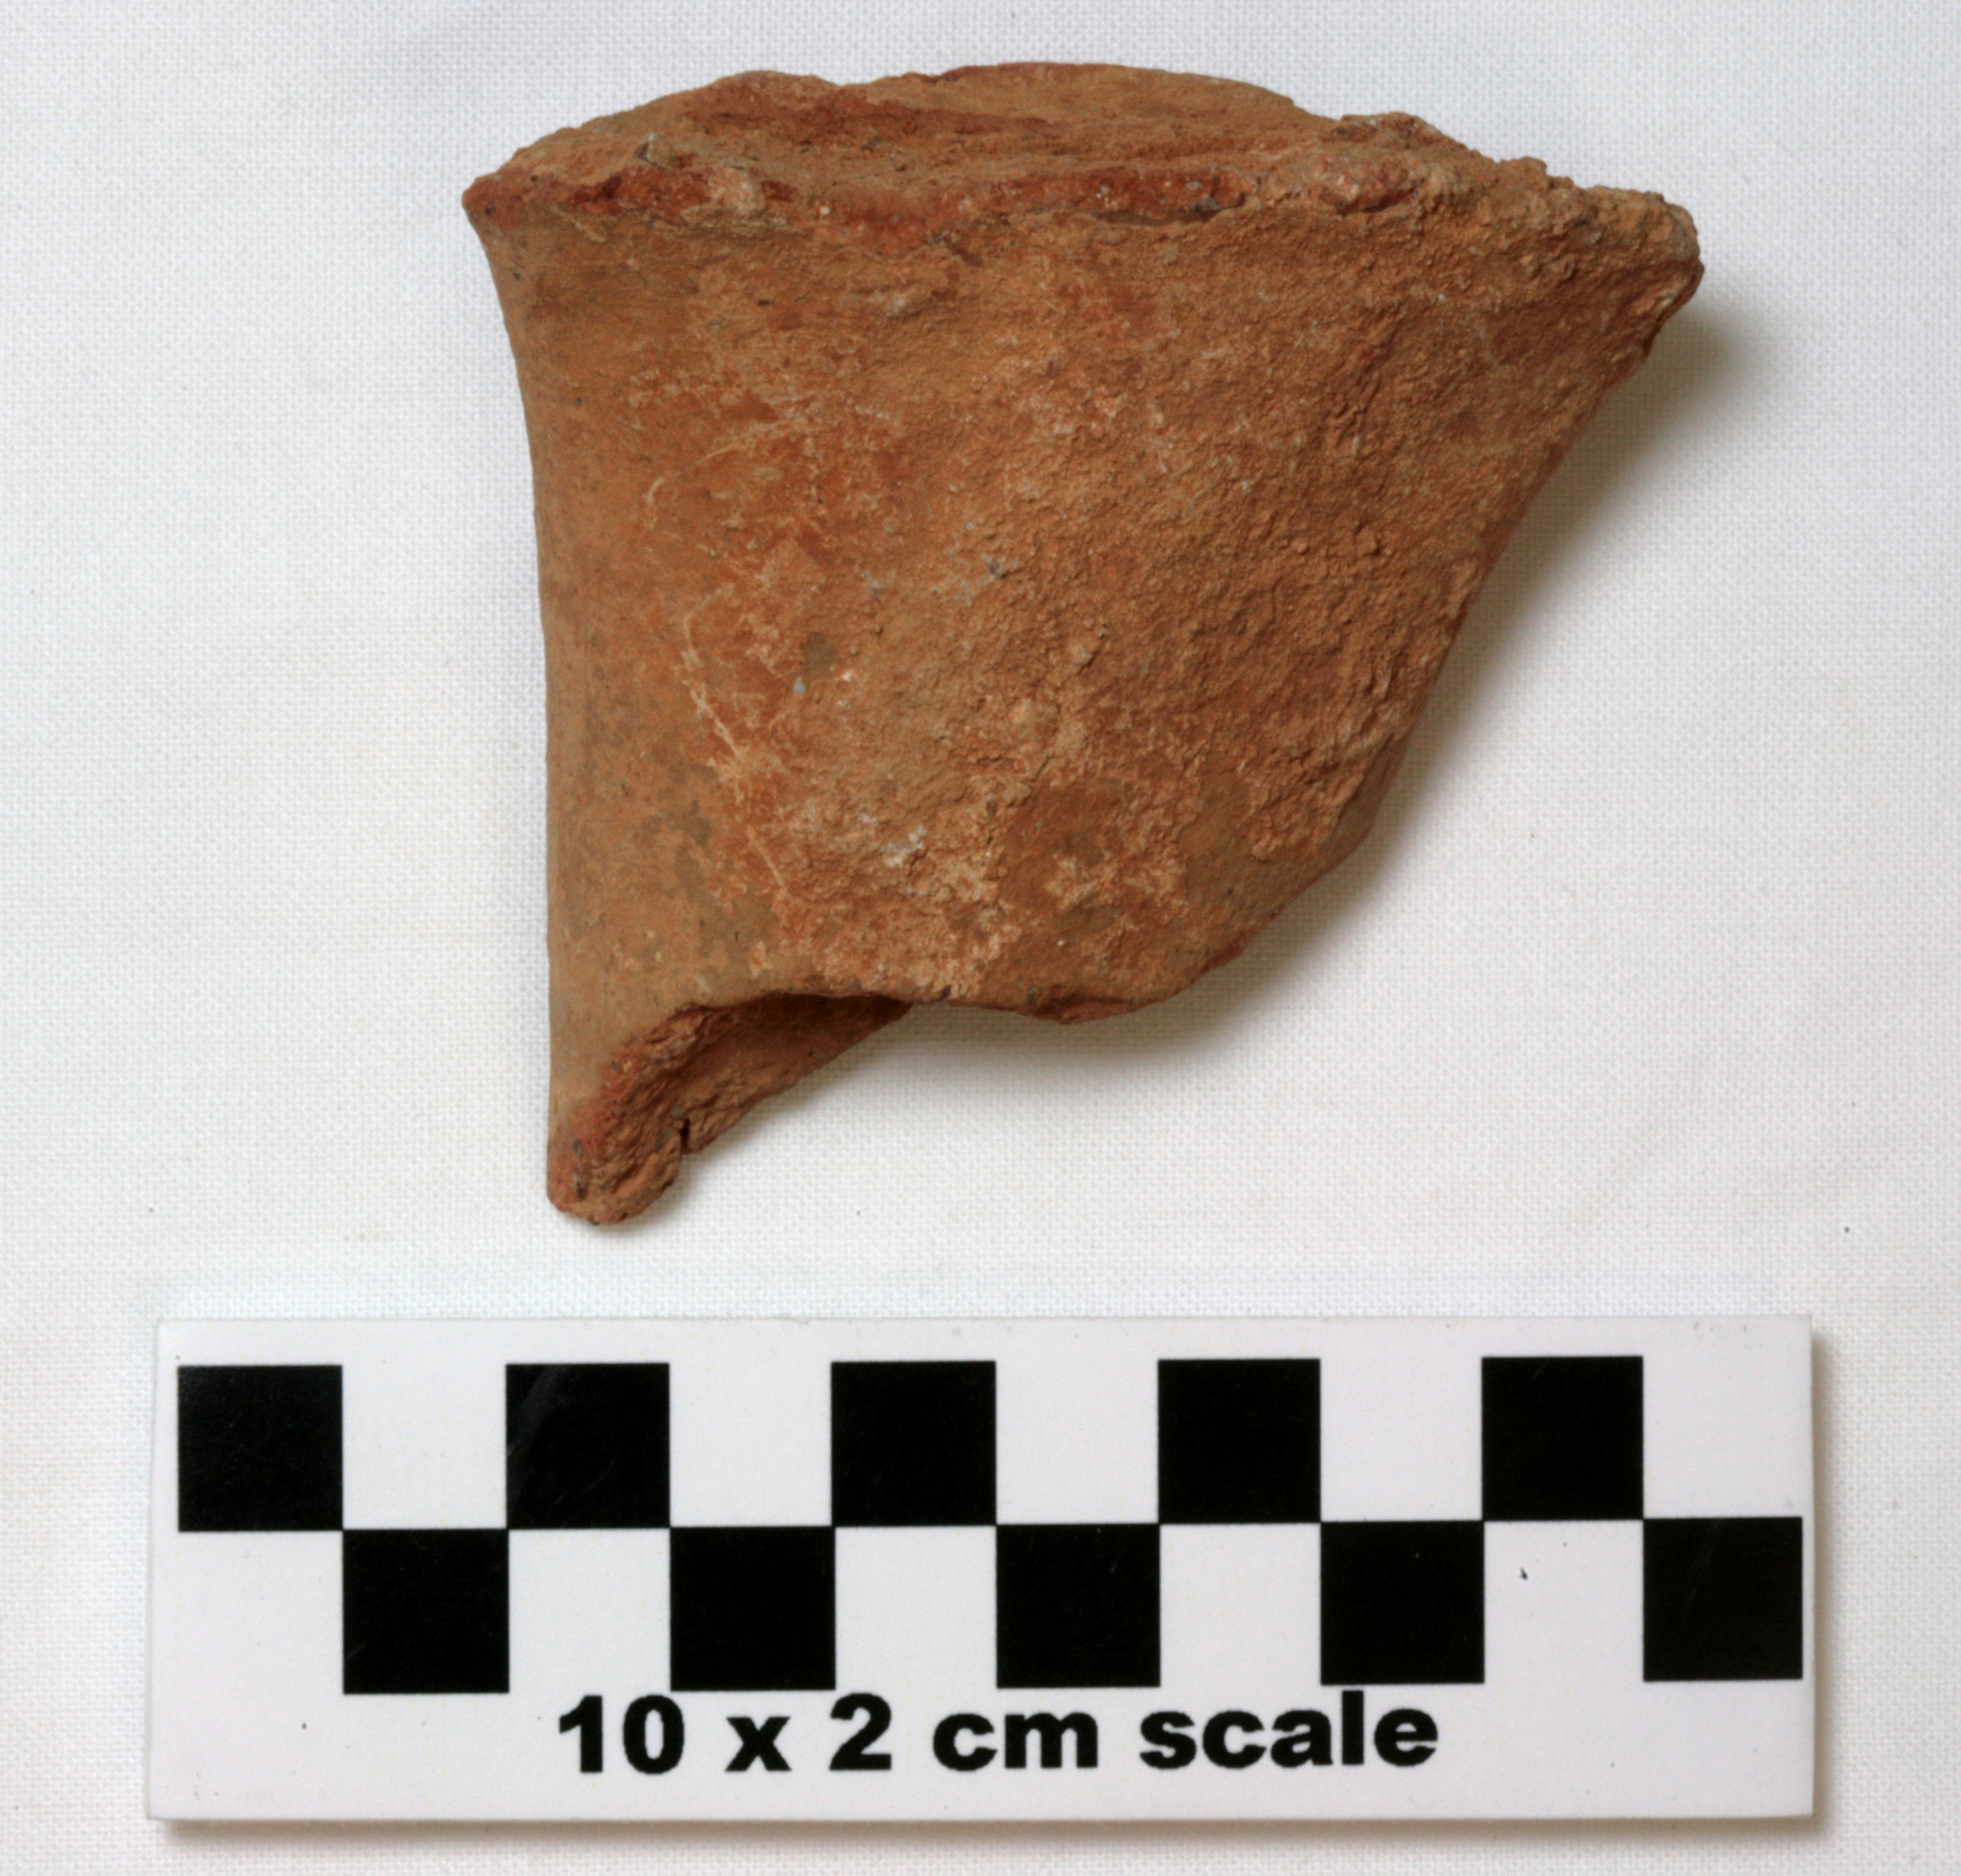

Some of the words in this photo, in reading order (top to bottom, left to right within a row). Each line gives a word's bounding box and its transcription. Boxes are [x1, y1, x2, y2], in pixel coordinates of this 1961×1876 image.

[559, 1695, 685, 1775] 10
[726, 1716, 791, 1772] x
[829, 1692, 892, 1771] 2
[933, 1712, 1099, 1772] cm
[1140, 1690, 1438, 1770] scale
